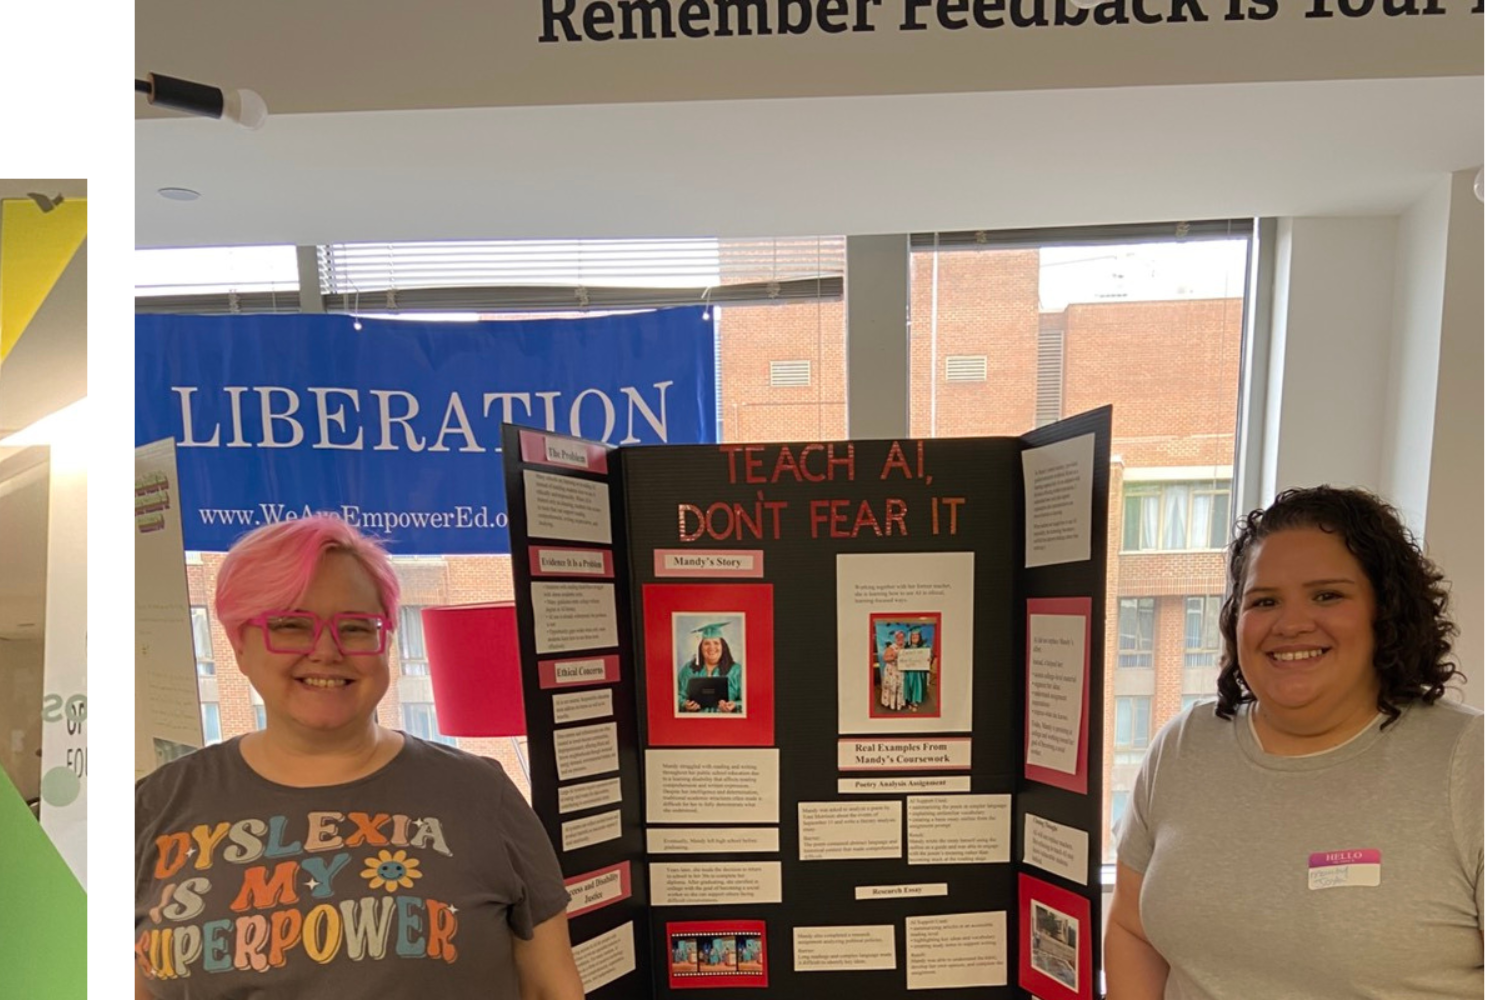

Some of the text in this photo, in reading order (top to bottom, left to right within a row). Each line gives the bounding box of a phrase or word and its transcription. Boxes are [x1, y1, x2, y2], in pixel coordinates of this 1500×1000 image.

[538, 0, 878, 42] Remember
[171, 380, 673, 452] LIBERATION
[548, 447, 586, 464] The Problem
[720, 440, 933, 486] TEACH AI,
[678, 490, 966, 542] DON'T FEAR IT
[541, 556, 566, 567] Evidence
[583, 558, 602, 569] Problem
[673, 556, 742, 569] Mandy's Story
[557, 665, 604, 678] Ethical Concerns
[855, 743, 947, 753] Real Examples From
[855, 754, 950, 765] Mandy's Coursework
[879, 780, 907, 788] Analysis
[908, 780, 946, 788] Assignment
[154, 811, 453, 880] DYSLEXIA
[1326, 851, 1363, 861] HELLO
[150, 852, 351, 925] IS MY
[584, 881, 595, 891] and
[595, 873, 618, 887] Disability
[584, 892, 603, 904] Justice
[872, 886, 922, 895] Research Essay
[135, 895, 458, 980] SUPERPOWER
